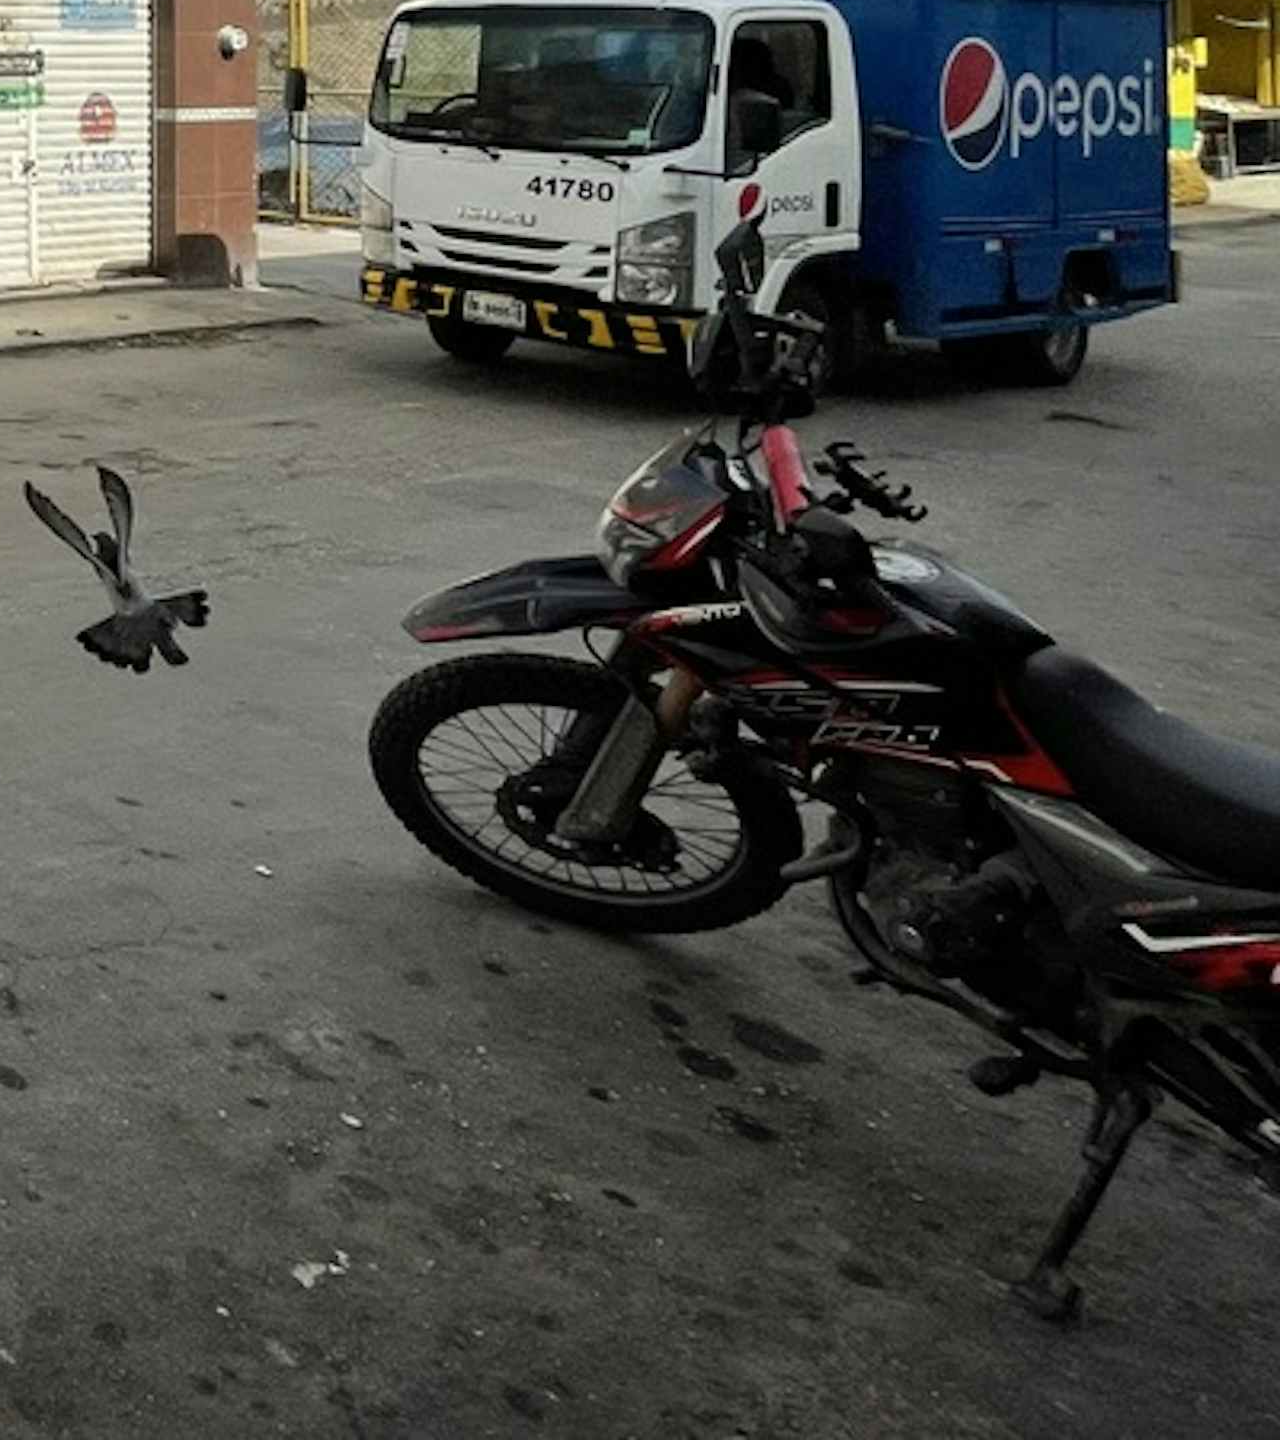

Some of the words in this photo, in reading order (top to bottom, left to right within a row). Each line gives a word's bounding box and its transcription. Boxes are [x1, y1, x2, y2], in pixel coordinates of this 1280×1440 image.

[1010, 58, 1153, 158] pepsi
[526, 175, 615, 202] 41780
[770, 190, 814, 218] pepsi
